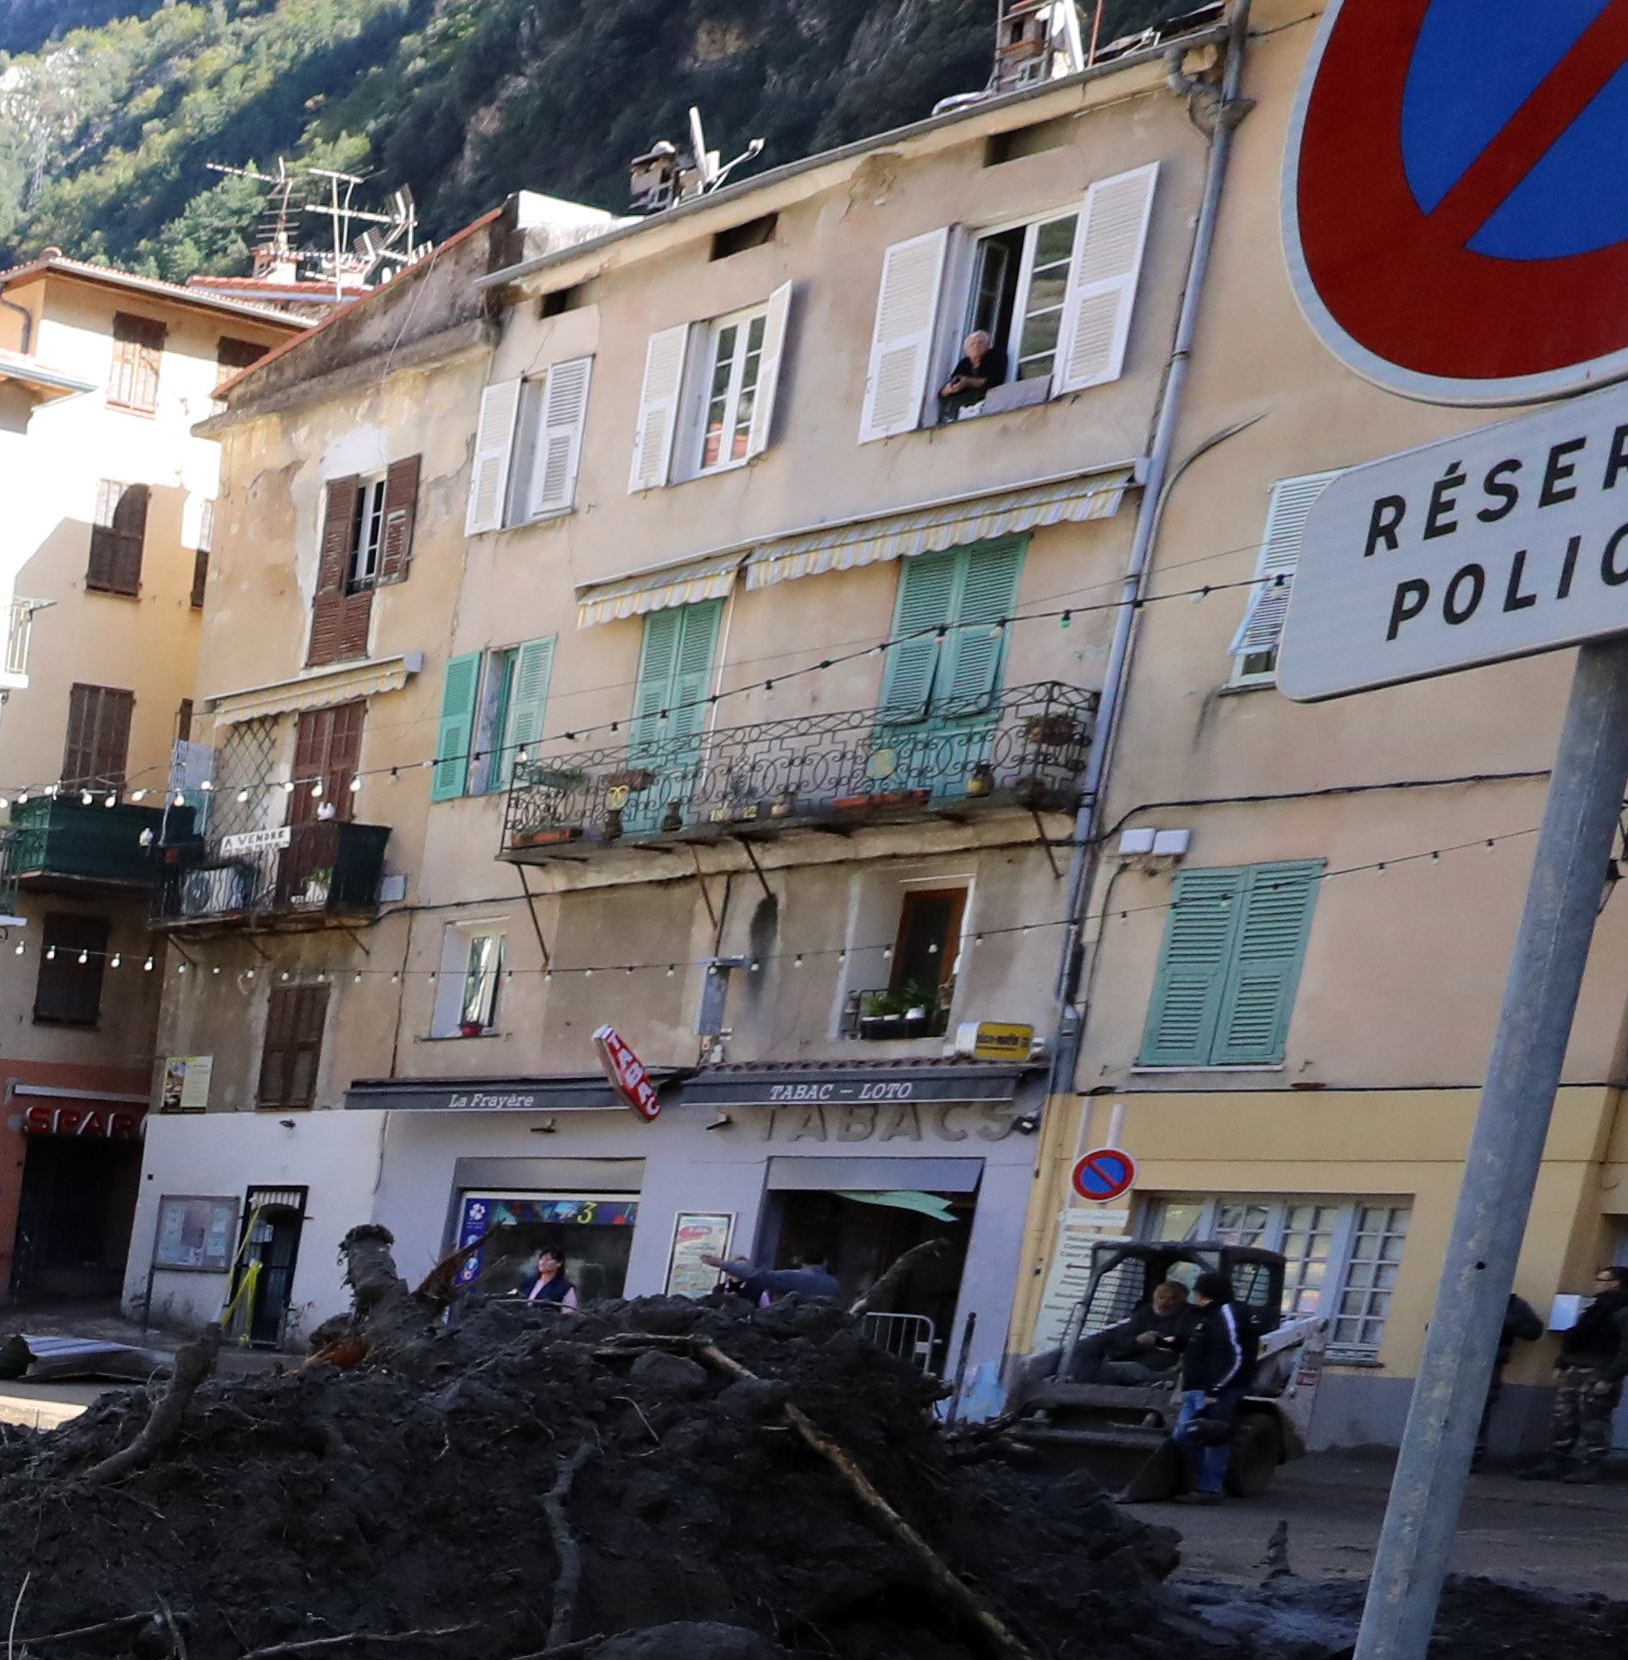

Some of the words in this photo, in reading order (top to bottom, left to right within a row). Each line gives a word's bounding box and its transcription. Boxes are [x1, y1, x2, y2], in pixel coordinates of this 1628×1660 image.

[607, 1033, 660, 1116] TABAC
[770, 1084, 833, 1100] TABAC
[858, 1082, 913, 1099] LOTO
[449, 1094, 467, 1107] La
[470, 1093, 534, 1109] Frayère
[25, 1106, 133, 1139] SPAR
[760, 1102, 1016, 1142] TABACS
